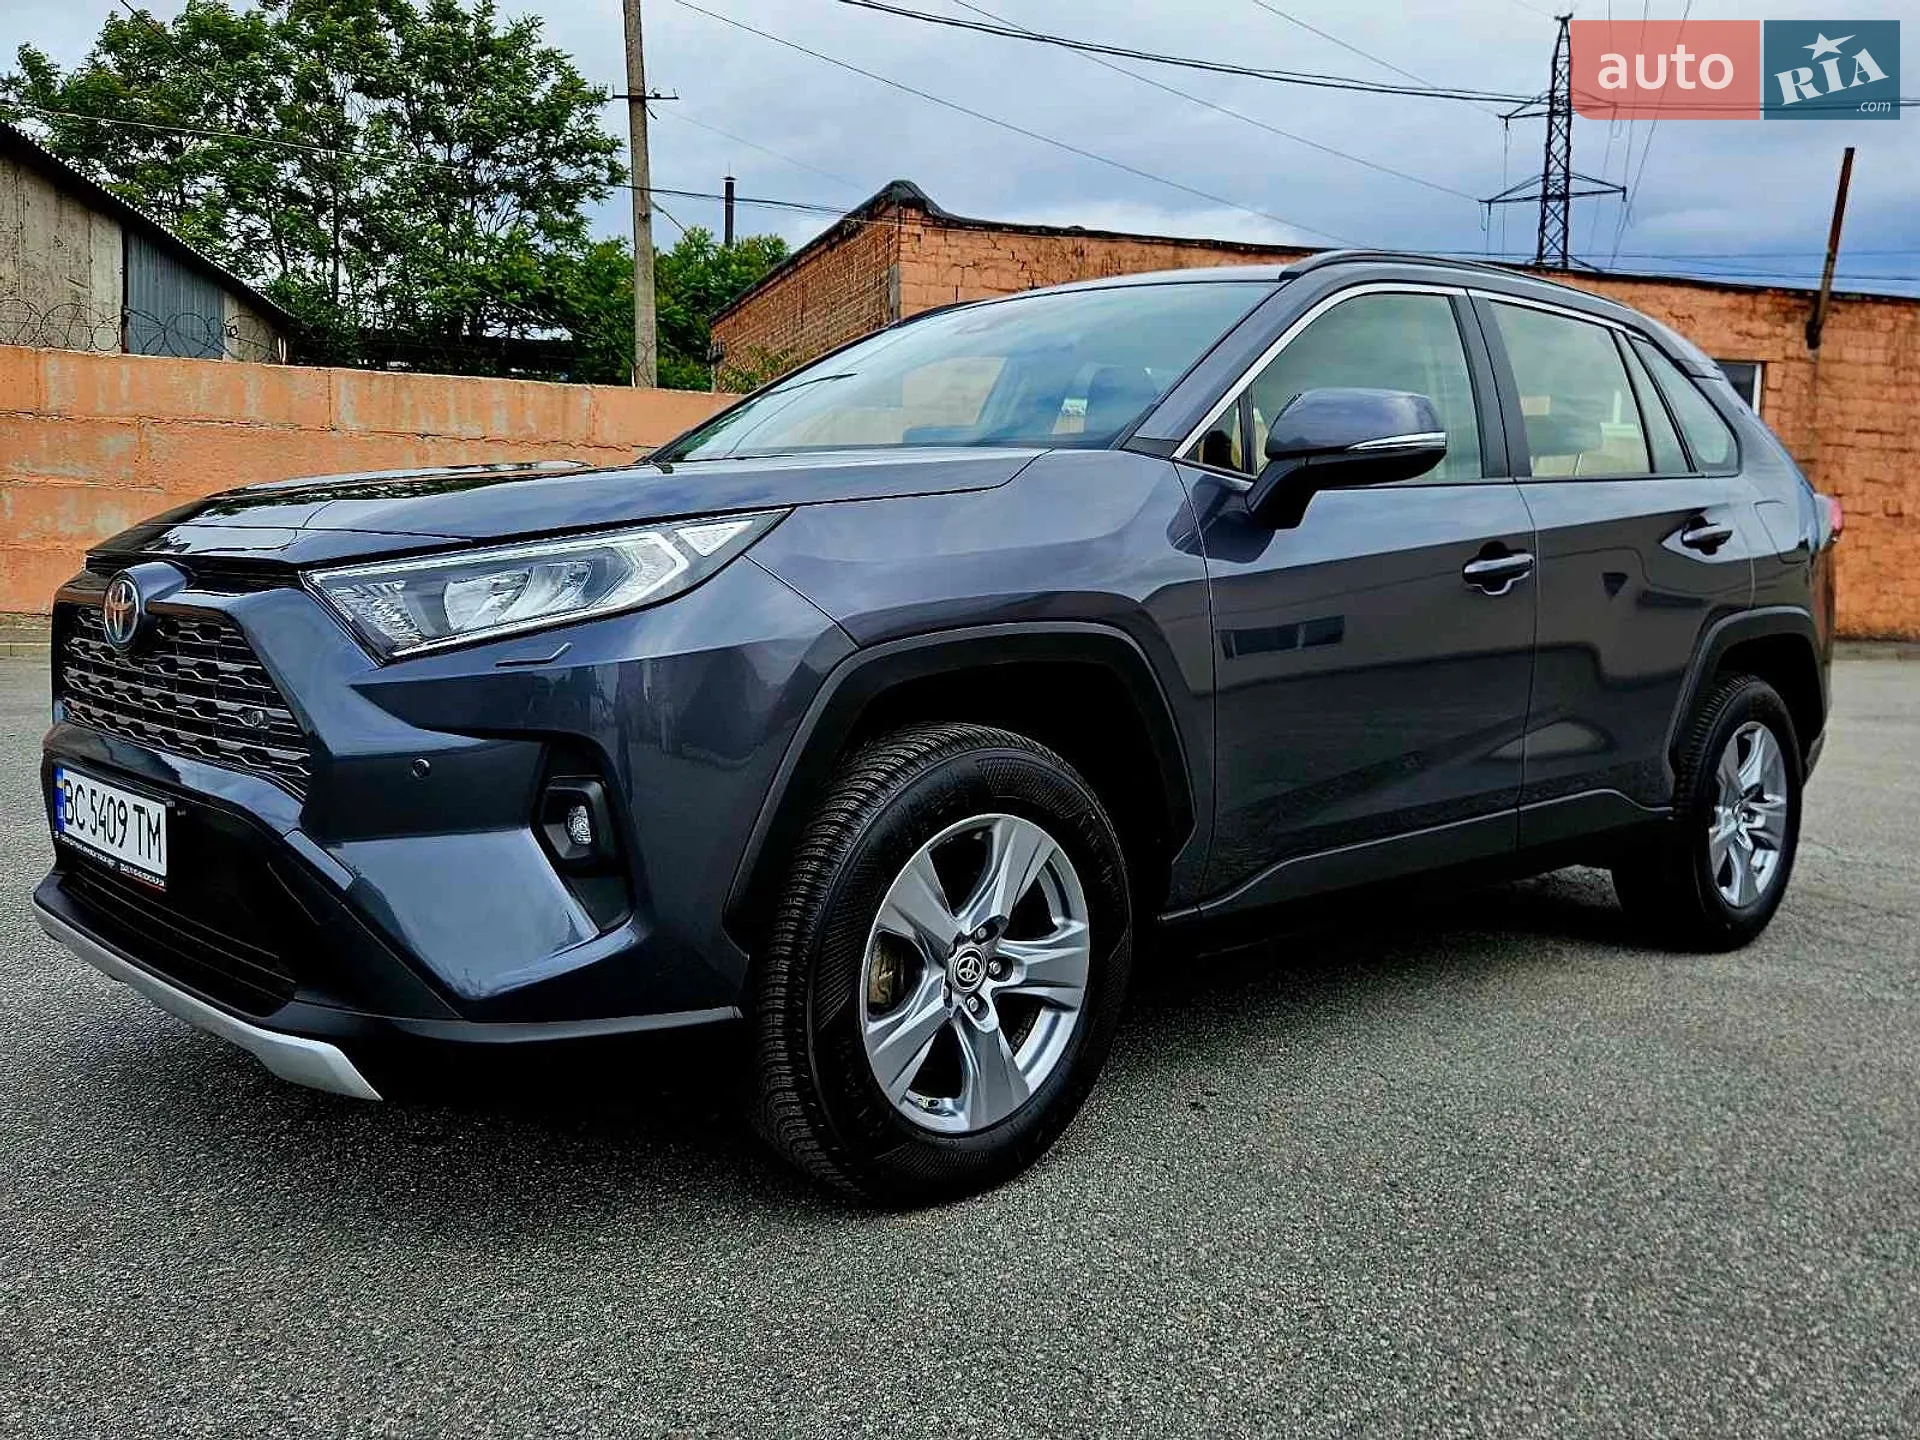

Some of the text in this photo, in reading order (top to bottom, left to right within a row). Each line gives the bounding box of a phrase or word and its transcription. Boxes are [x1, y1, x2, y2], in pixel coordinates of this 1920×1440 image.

[63, 778, 85, 831] BC
[90, 788, 128, 848] 5409
[133, 804, 162, 863] TM
